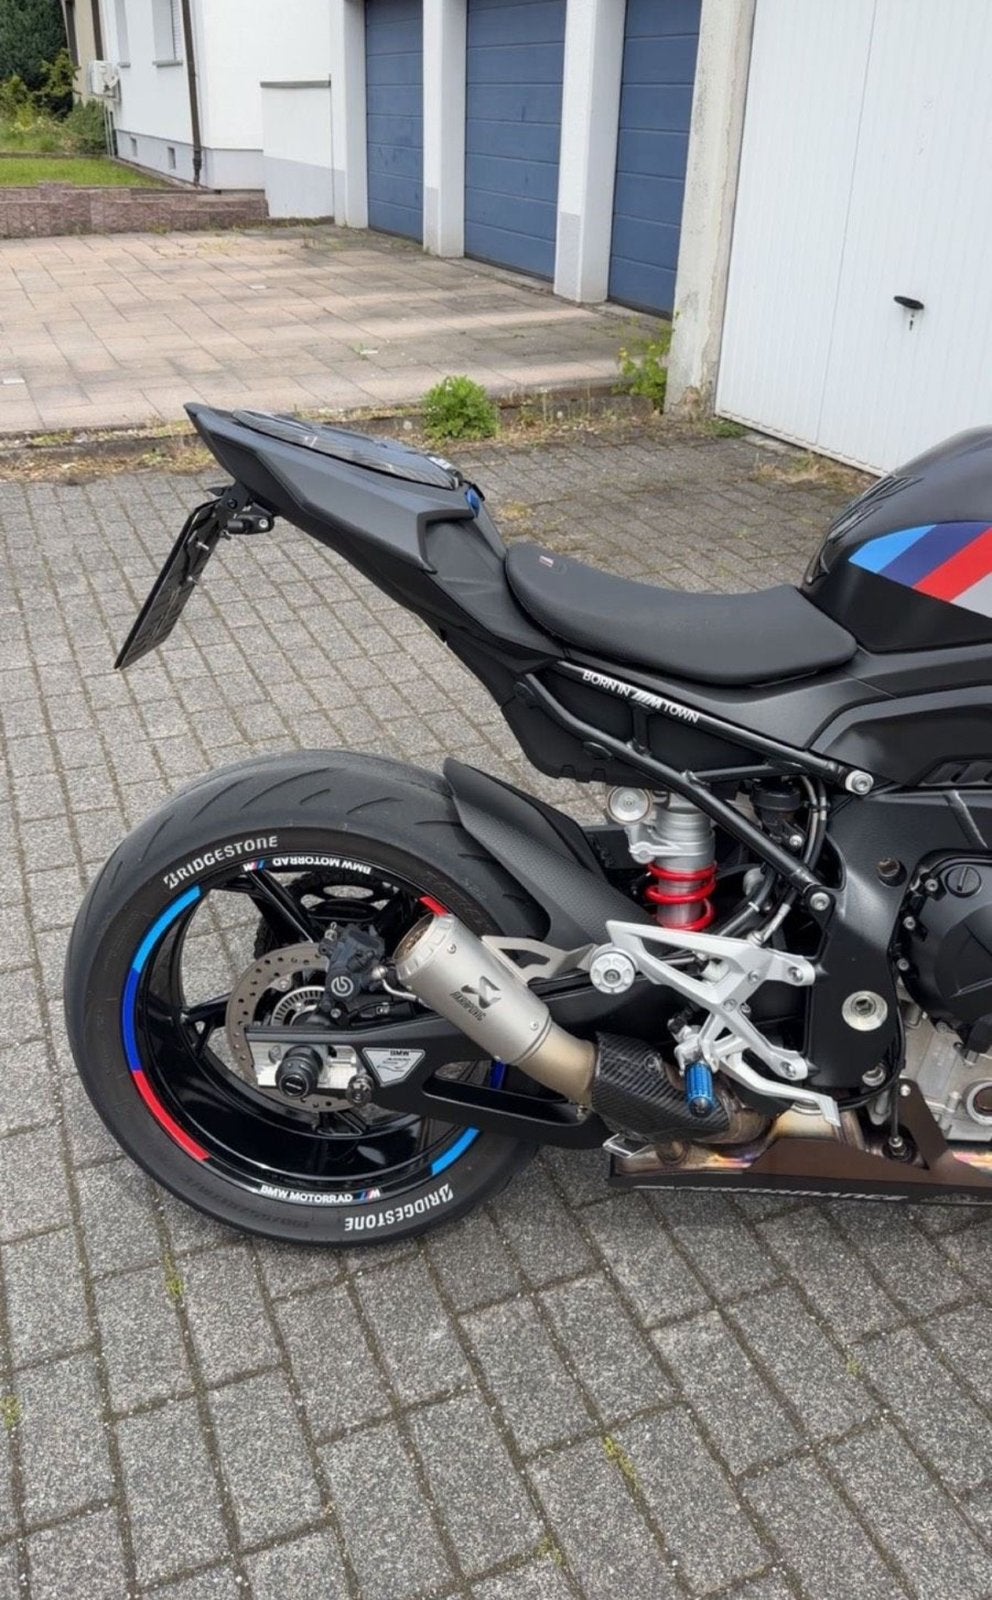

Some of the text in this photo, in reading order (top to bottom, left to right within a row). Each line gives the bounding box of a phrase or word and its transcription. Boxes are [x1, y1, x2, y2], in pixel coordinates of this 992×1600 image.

[582, 670, 618, 691] BORN
[616, 682, 631, 697] IN
[662, 701, 700, 723] TOWN
[163, 835, 278, 889] BRIDGESTONE
[272, 856, 340, 867] MOTORRAD
[341, 860, 371, 875] BMW
[261, 1184, 289, 1199] BMW
[289, 1190, 353, 1203] MOTORRAD
[344, 1183, 454, 1231] BRIDGESTONE
